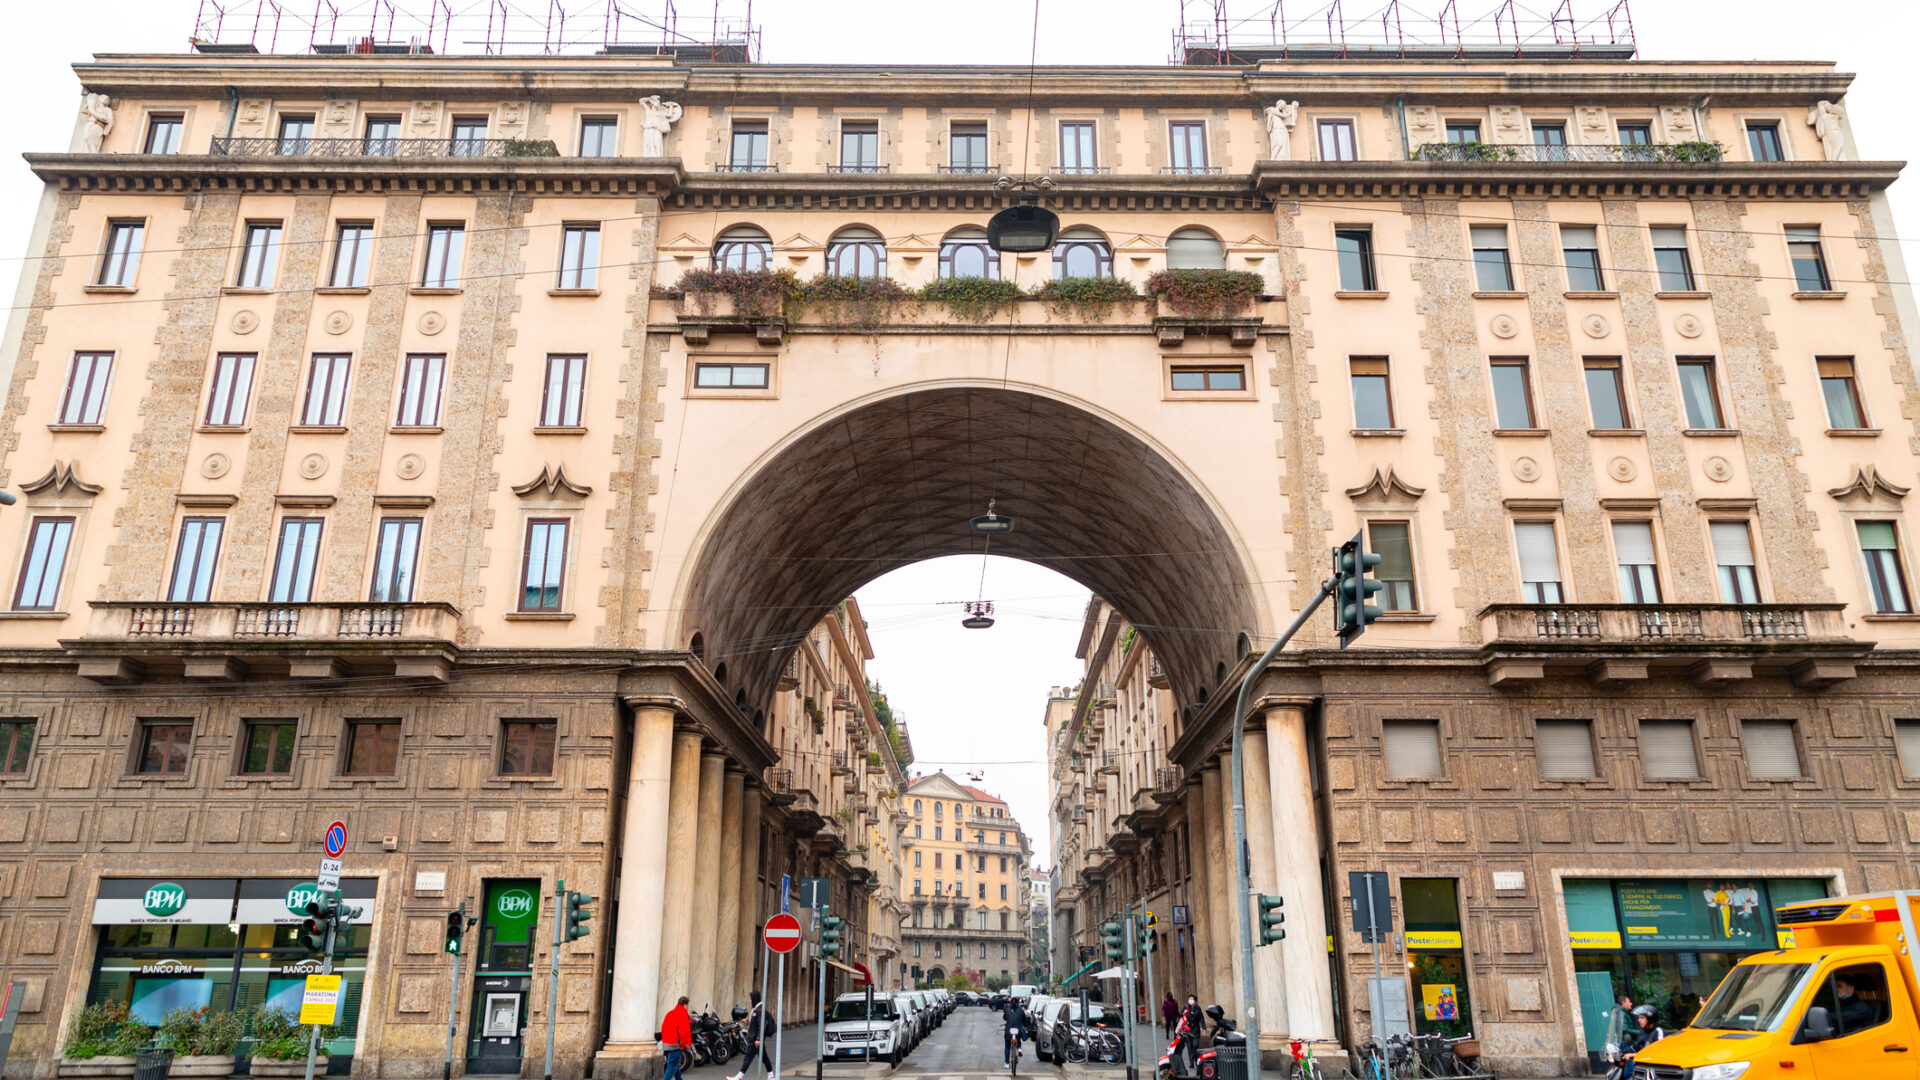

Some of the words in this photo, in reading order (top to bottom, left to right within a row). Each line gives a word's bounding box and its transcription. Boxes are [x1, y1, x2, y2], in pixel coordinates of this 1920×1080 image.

[144, 890, 184, 909] BPM
[499, 896, 531, 913] BPM
[142, 965, 173, 974] BANCO
[174, 965, 192, 974] BPM
[282, 965, 313, 974] BANCO
